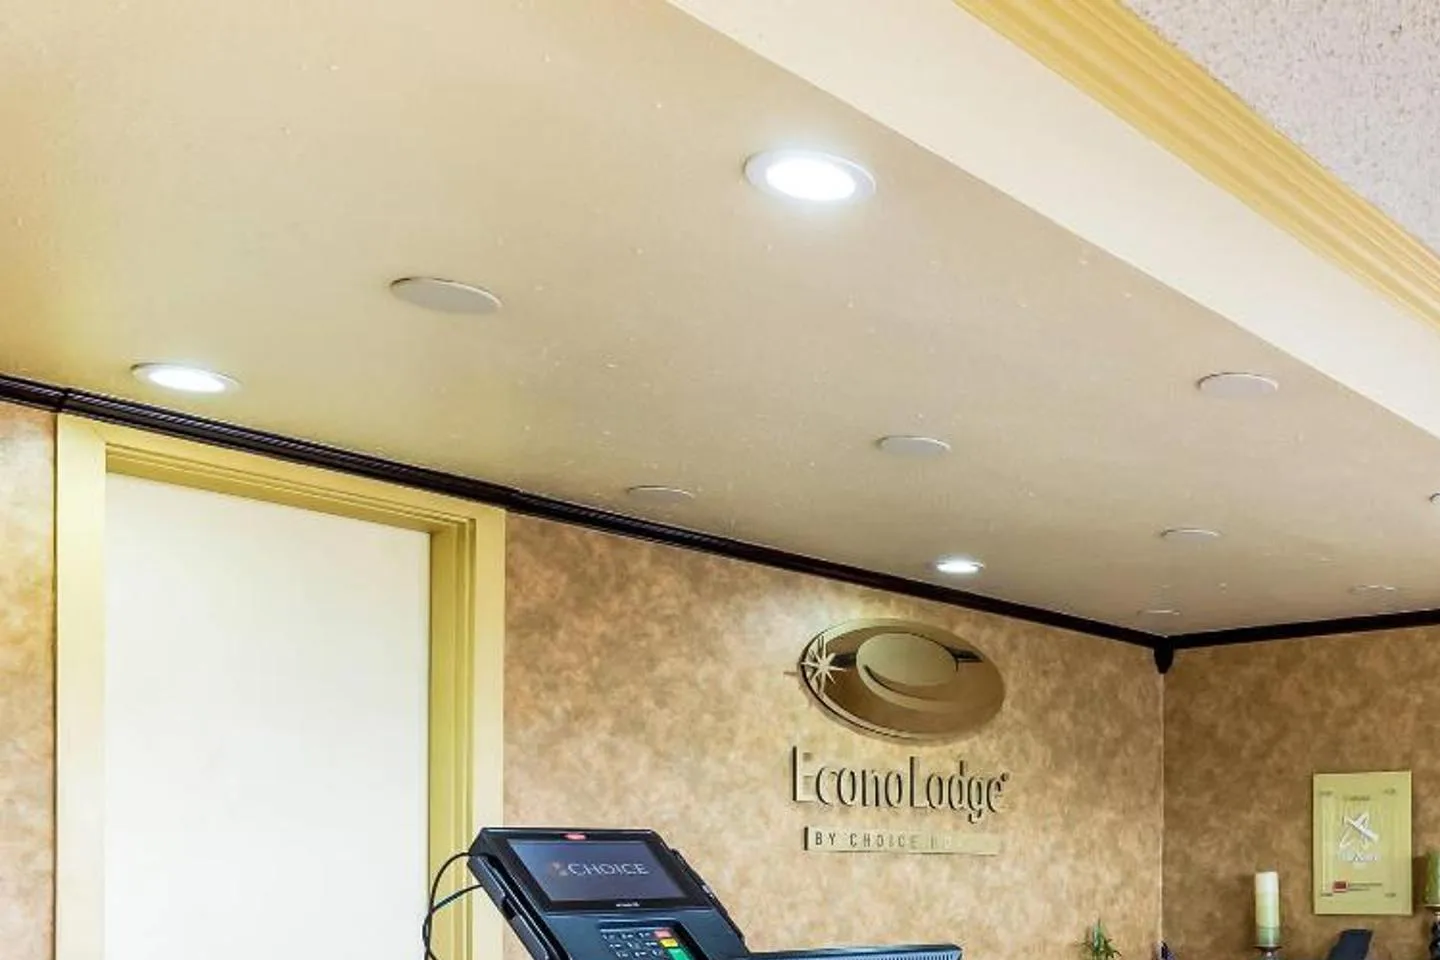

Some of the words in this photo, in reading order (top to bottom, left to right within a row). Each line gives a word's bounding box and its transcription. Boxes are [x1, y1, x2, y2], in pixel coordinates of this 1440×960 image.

[815, 831, 837, 847] BY
[849, 831, 918, 850] CHOICE
[567, 862, 650, 877] CHOICE
